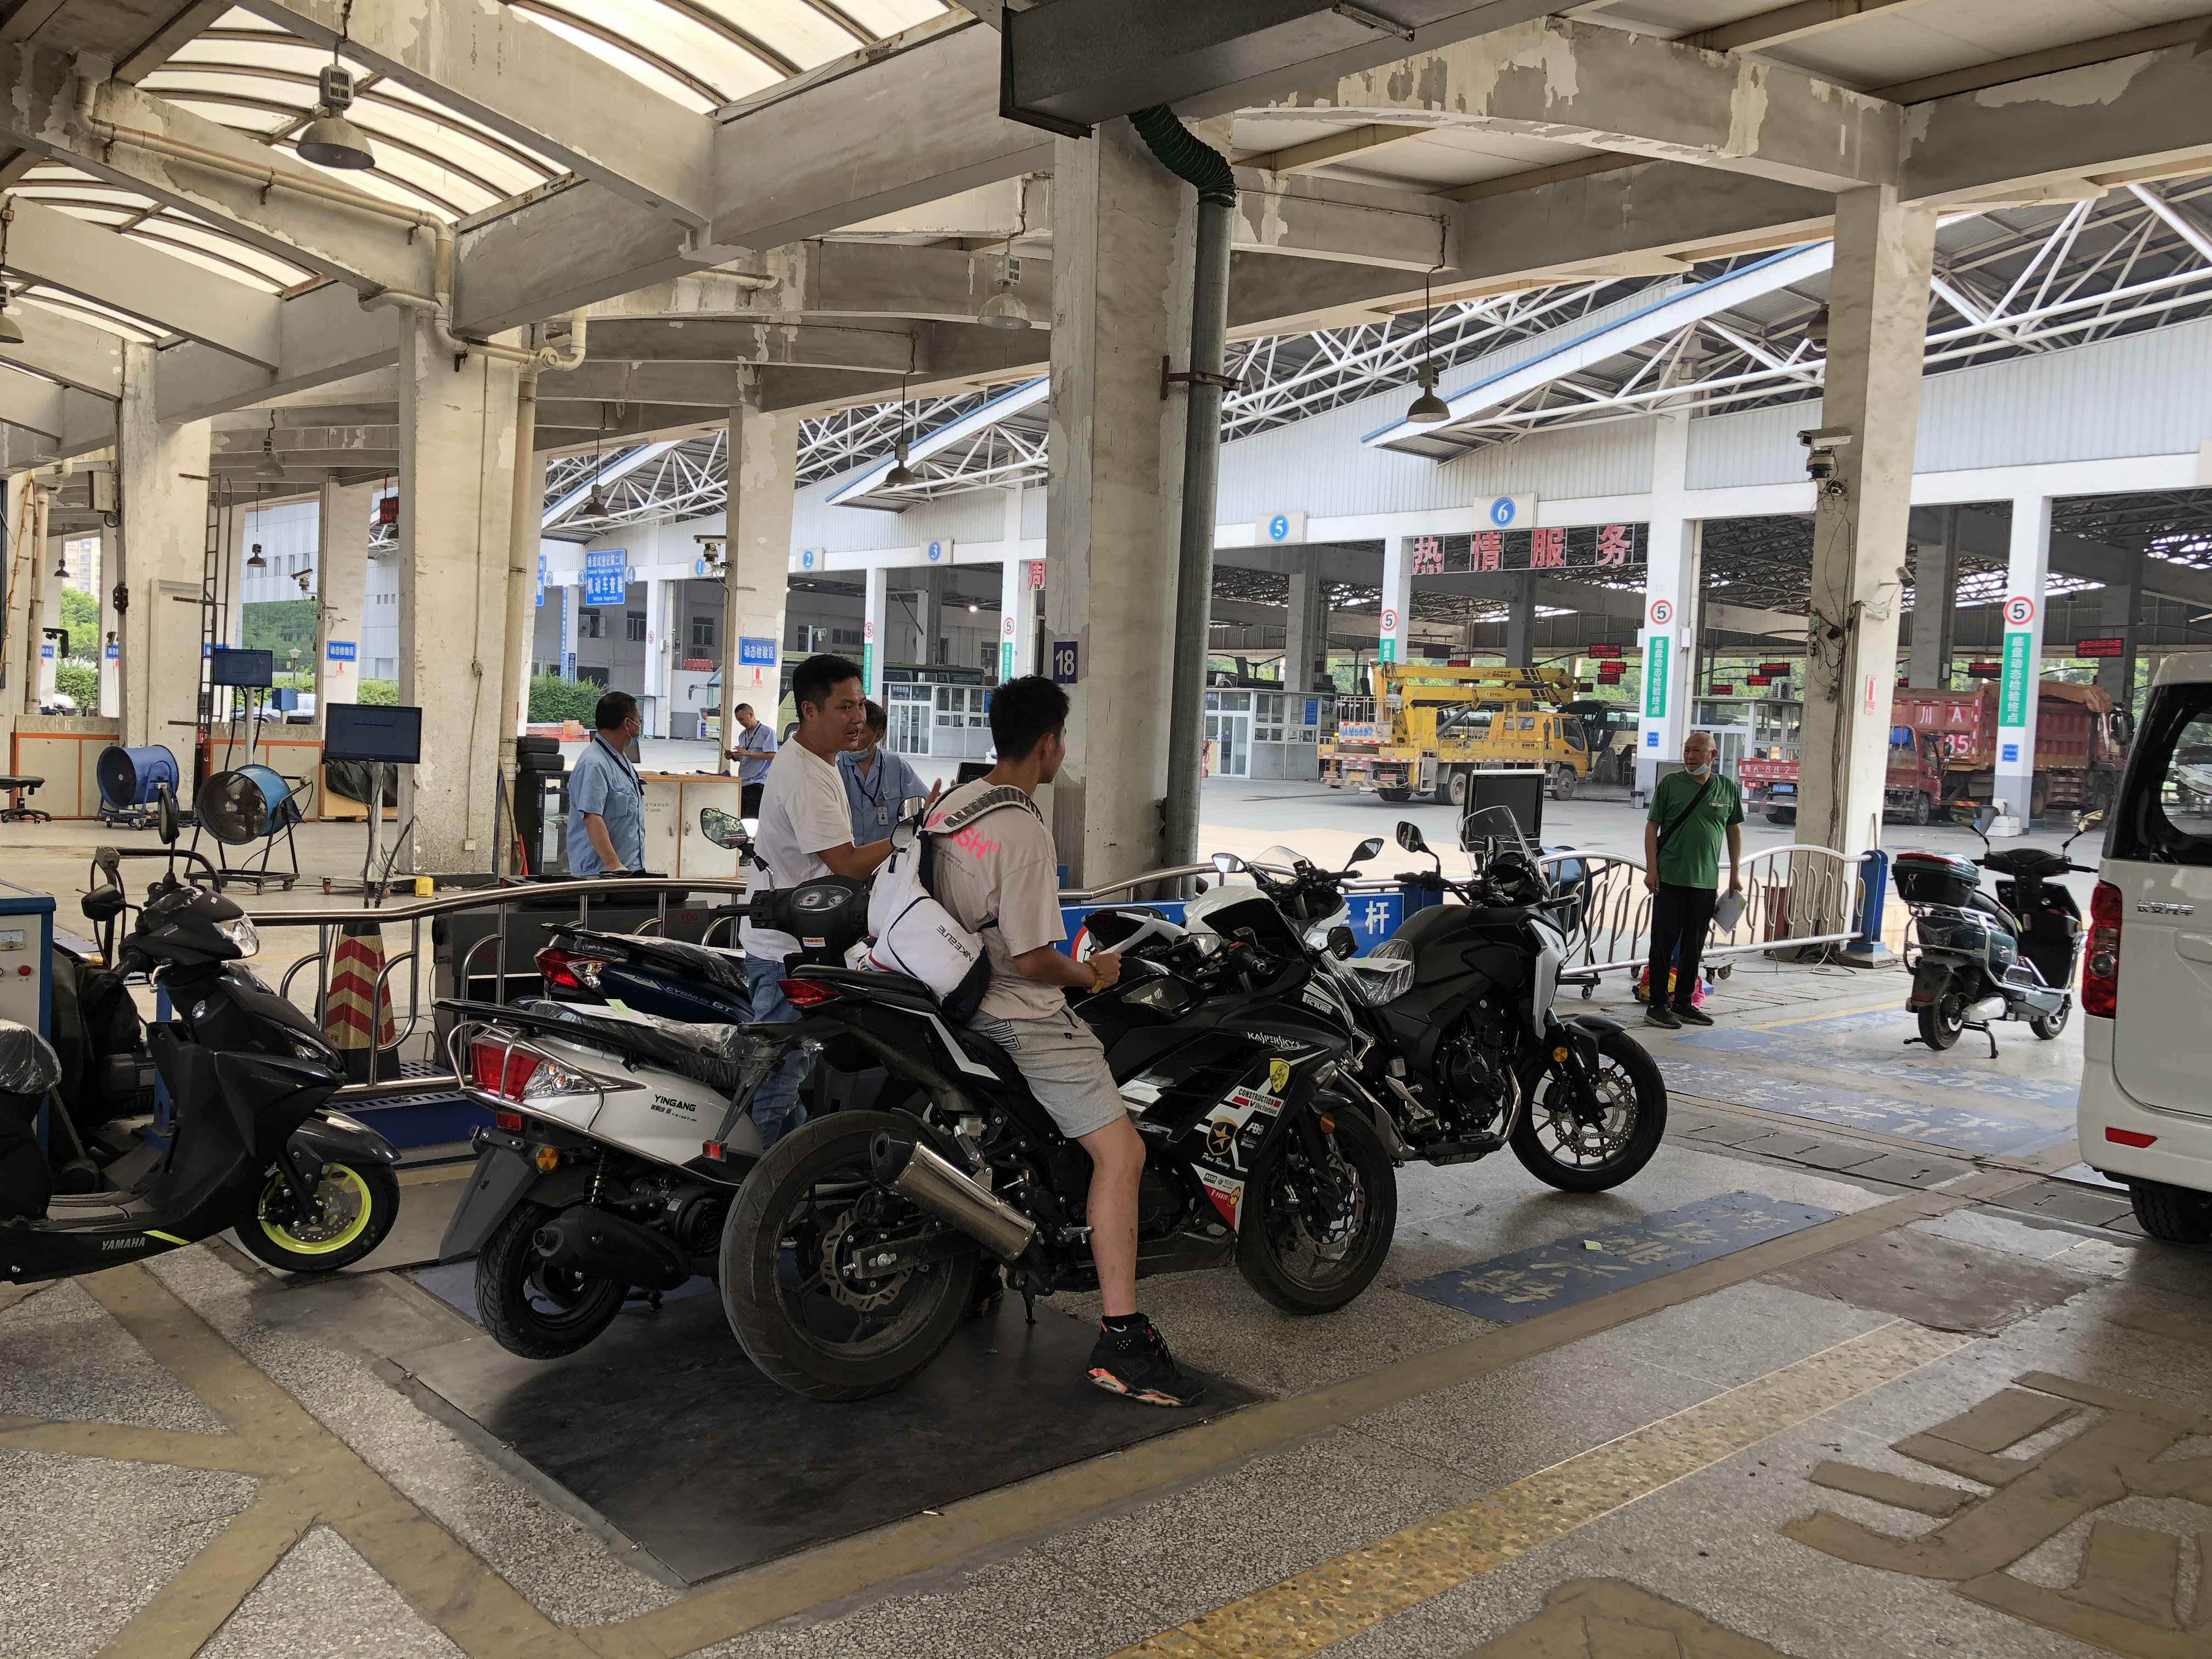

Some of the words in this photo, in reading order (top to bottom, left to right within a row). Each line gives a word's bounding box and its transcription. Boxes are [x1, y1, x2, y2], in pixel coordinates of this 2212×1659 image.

[1498, 503, 1509, 522] 6
[1274, 520, 1284, 537] 5
[931, 544, 938, 558] 3
[1413, 524, 1632, 575] 热情服务
[805, 553, 811, 566] 2
[548, 573, 552, 586] 2
[579, 571, 584, 585] 3
[628, 568, 633, 582] 4
[1028, 560, 1046, 590] 周
[587, 574, 623, 595] 机动车查验
[1657, 606, 1666, 619] 5
[2012, 603, 2025, 619] 5
[1007, 622, 1011, 631] 5
[1385, 614, 1392, 626] 5
[867, 625, 871, 634] 5
[744, 644, 774, 659] 动态检验区
[1056, 650, 1074, 675] 18
[1651, 639, 1664, 715] 底盘动态检验终点
[2007, 636, 2024, 724] 底盘动态检验终点
[1865, 701, 1875, 710] FIRE
[1920, 706, 1932, 724] 川
[1951, 706, 1962, 723] A
[2137, 900, 2194, 916] 长安汽车
[666, 986, 710, 1004] CYGNUS
[713, 1001, 734, 1012] GT
[655, 1094, 697, 1112] YINGANG
[1238, 1088, 1275, 1106] CONSTRUCTION
[1202, 1152, 1214, 1162] Pure
[1215, 1158, 1231, 1169] Racing
[102, 1237, 145, 1250] YAMAHA
